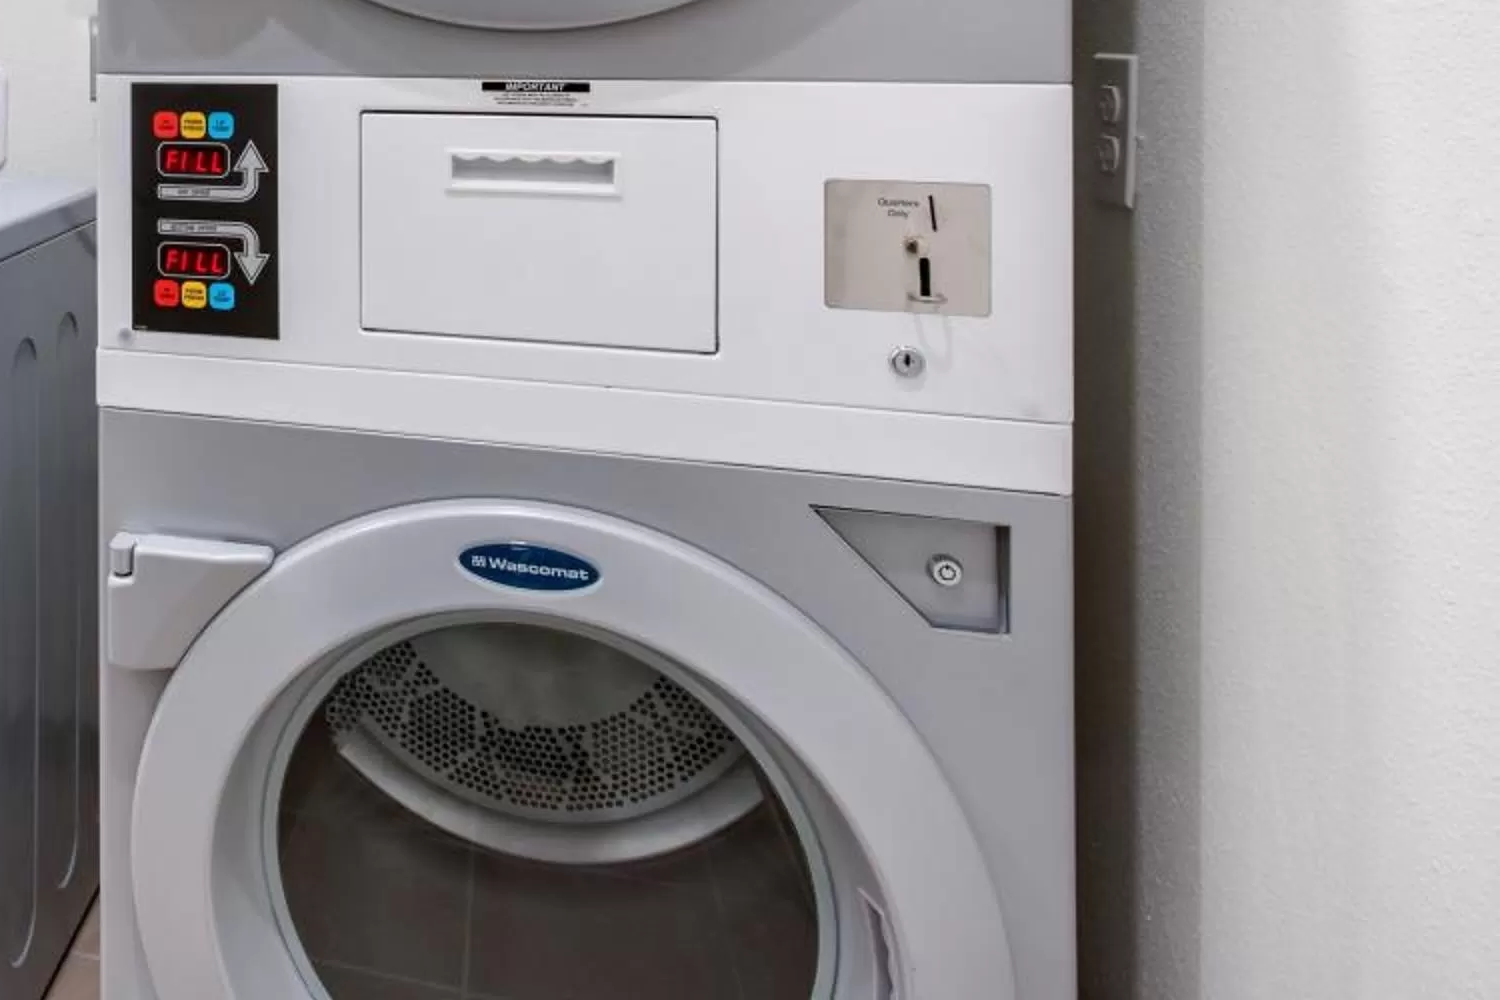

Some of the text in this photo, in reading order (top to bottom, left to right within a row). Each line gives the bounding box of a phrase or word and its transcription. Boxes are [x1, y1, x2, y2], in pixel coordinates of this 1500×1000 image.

[166, 150, 223, 173] FILL
[165, 249, 223, 273] FILL
[488, 556, 589, 581] Wascomat
